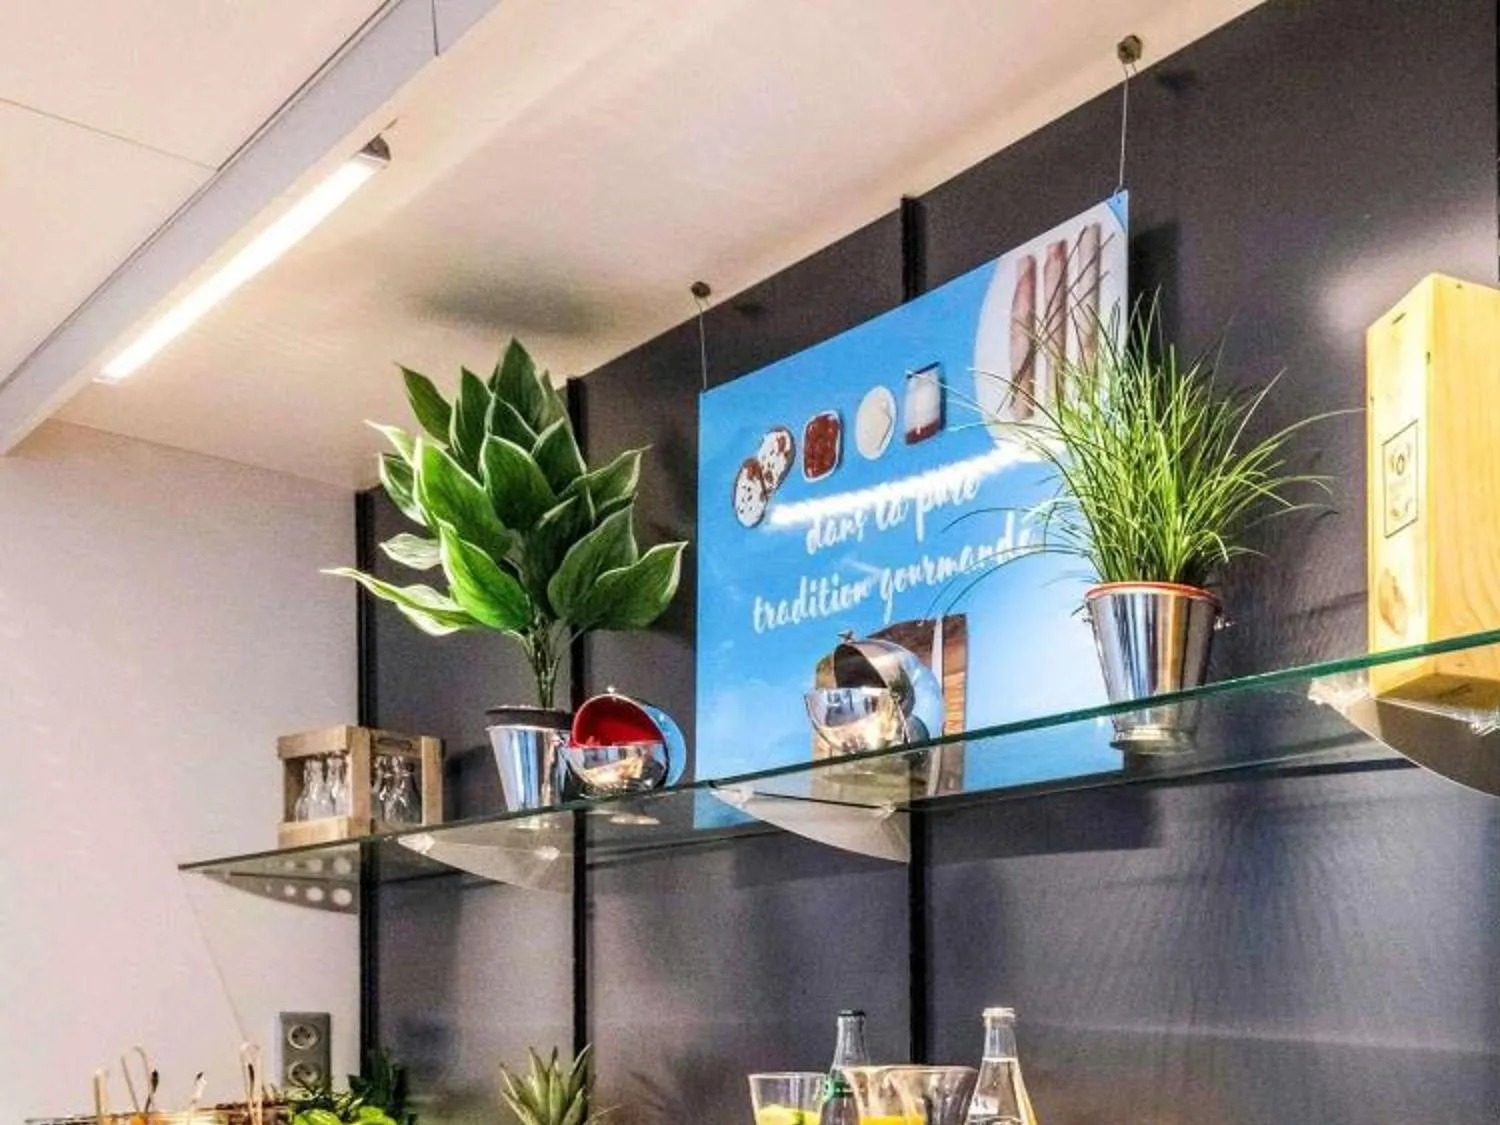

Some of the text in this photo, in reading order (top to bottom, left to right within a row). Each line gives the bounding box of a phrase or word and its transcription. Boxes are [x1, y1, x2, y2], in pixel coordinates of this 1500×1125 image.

[753, 510, 1034, 633] tradition gourmande
[805, 508, 864, 554] dans
